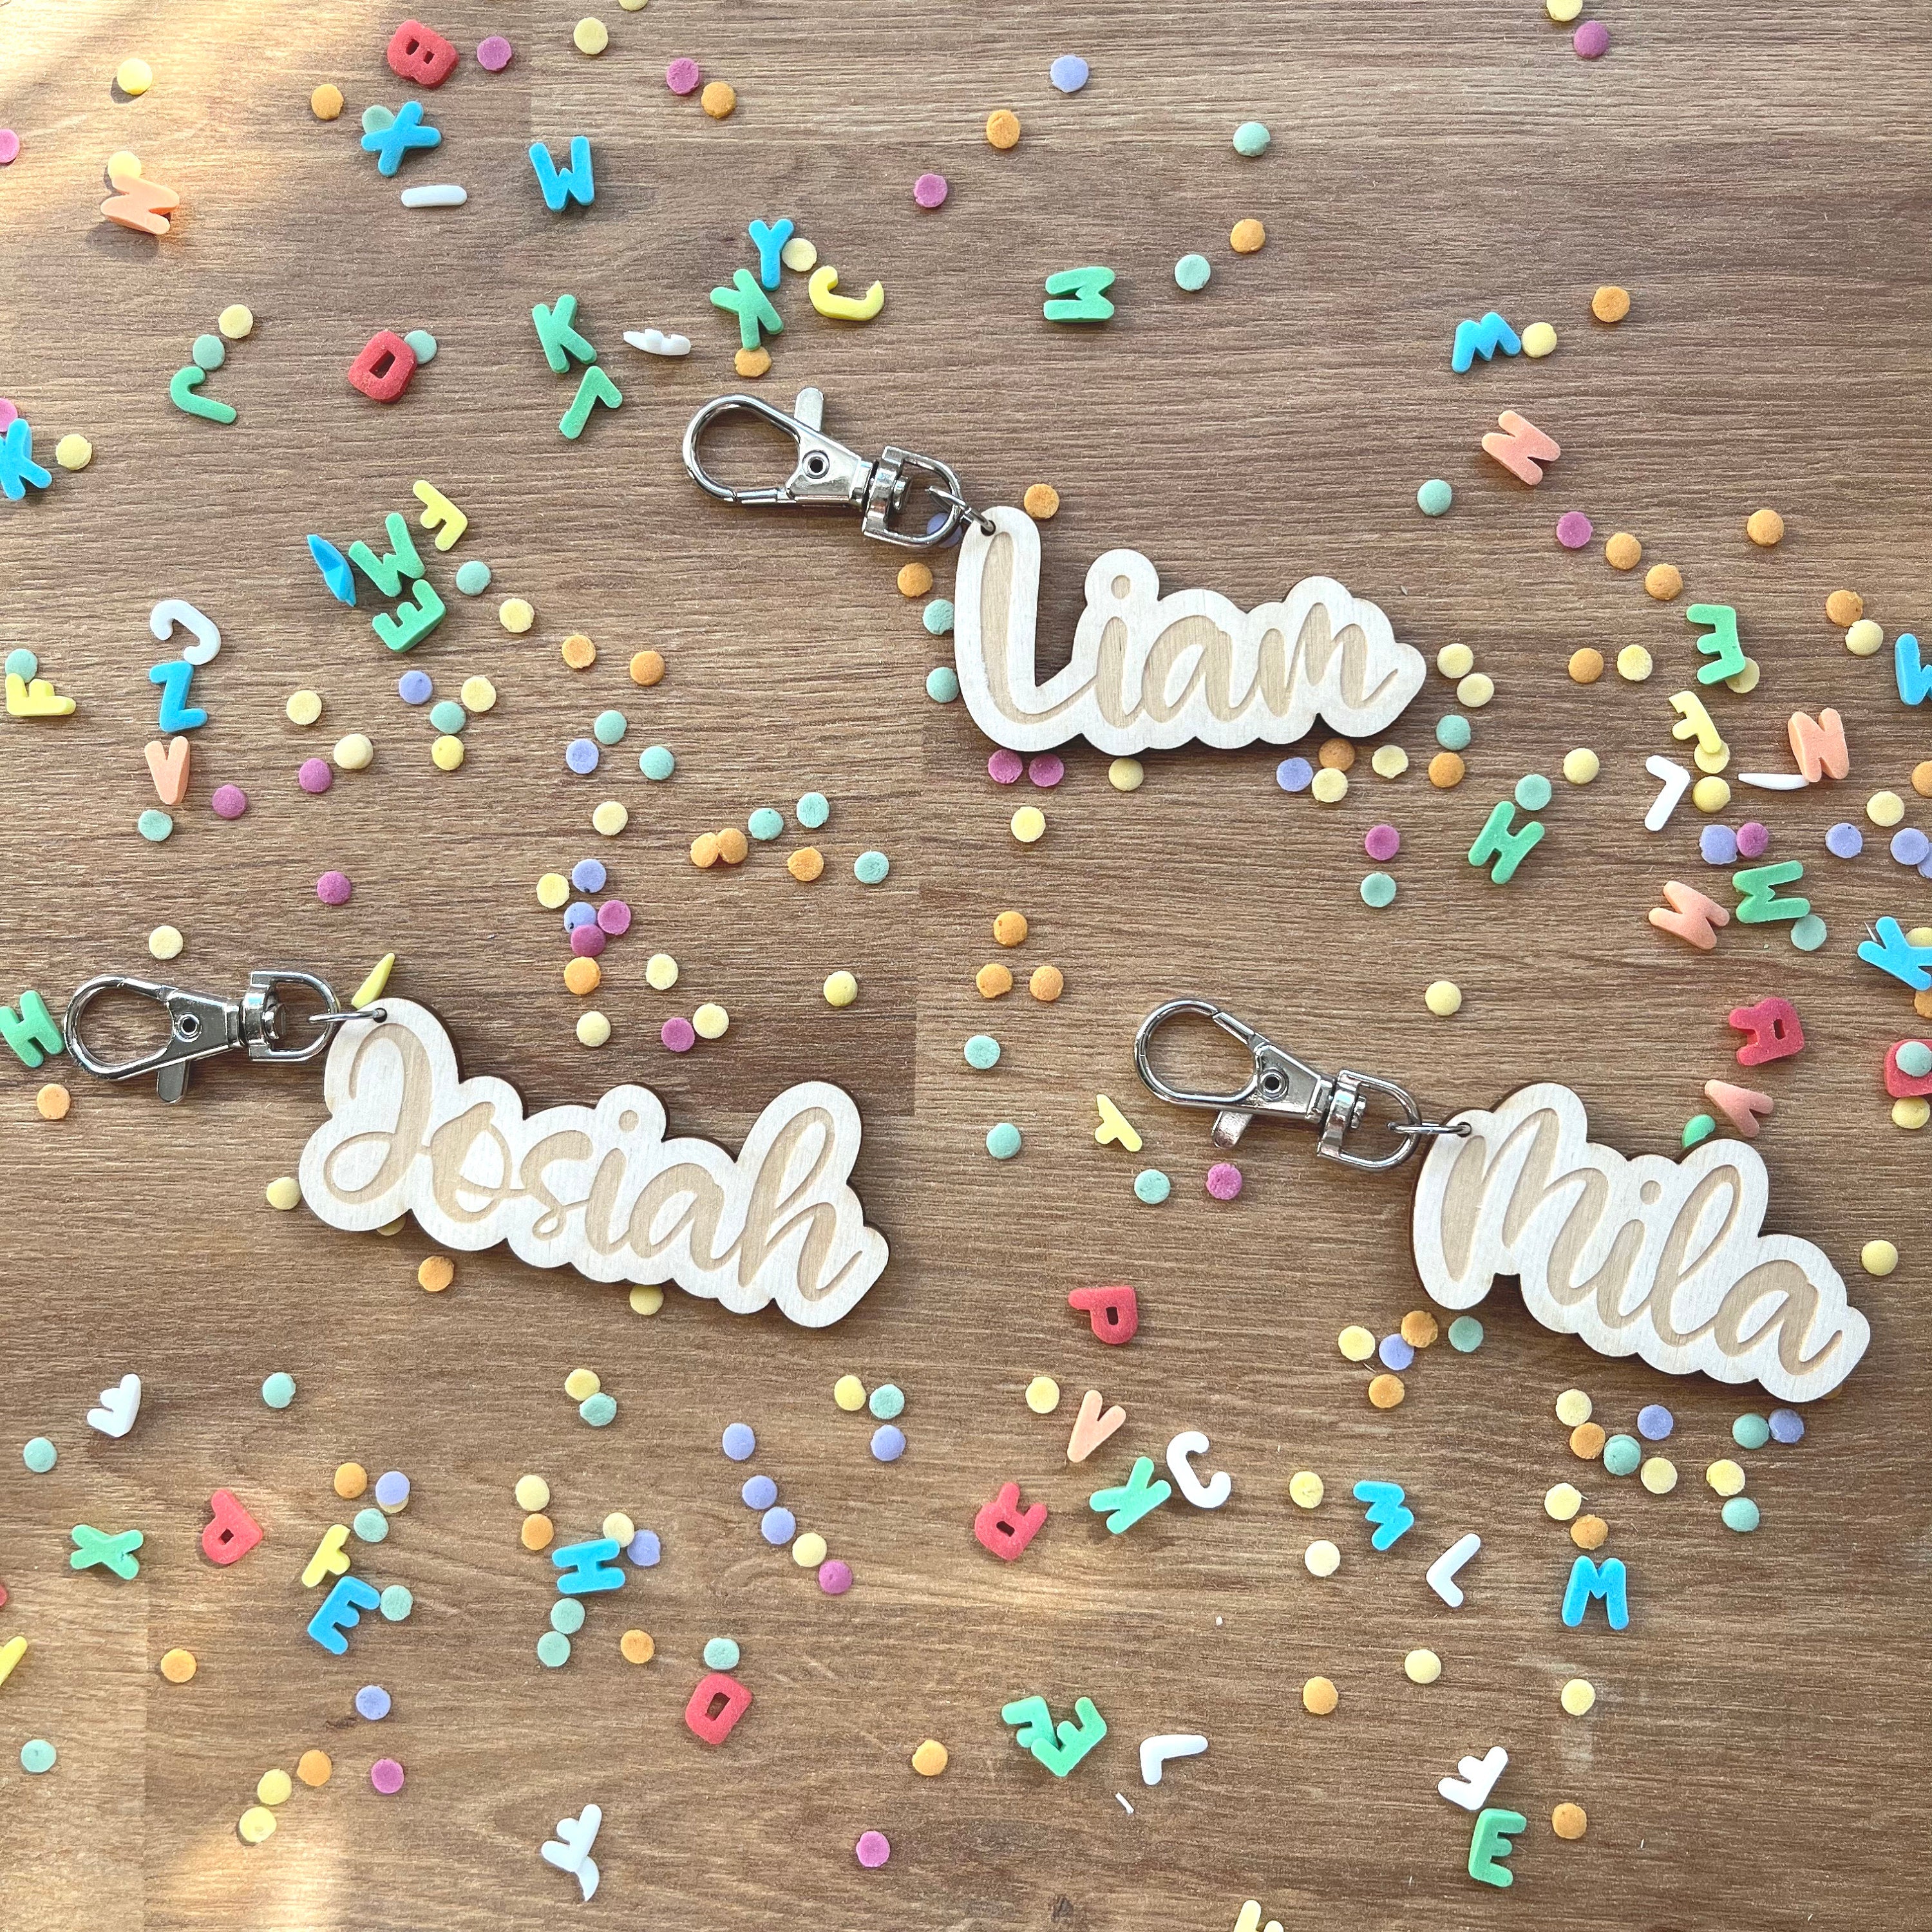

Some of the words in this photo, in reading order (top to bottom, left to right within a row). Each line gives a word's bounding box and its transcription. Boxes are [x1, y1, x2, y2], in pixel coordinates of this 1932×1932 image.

[749, 219, 794, 290] Y
[532, 294, 597, 374] K
[980, 531, 1399, 728] Liam
[144, 735, 190, 805] V
[1468, 800, 1545, 885] H
[323, 1023, 862, 1302] Josiah
[1440, 1107, 1842, 1376] Mila
[1166, 1430, 1232, 1509] C
[307, 1575, 381, 1655] E
[1561, 1555, 1629, 1630] M
[1468, 1808, 1527, 1888] E
